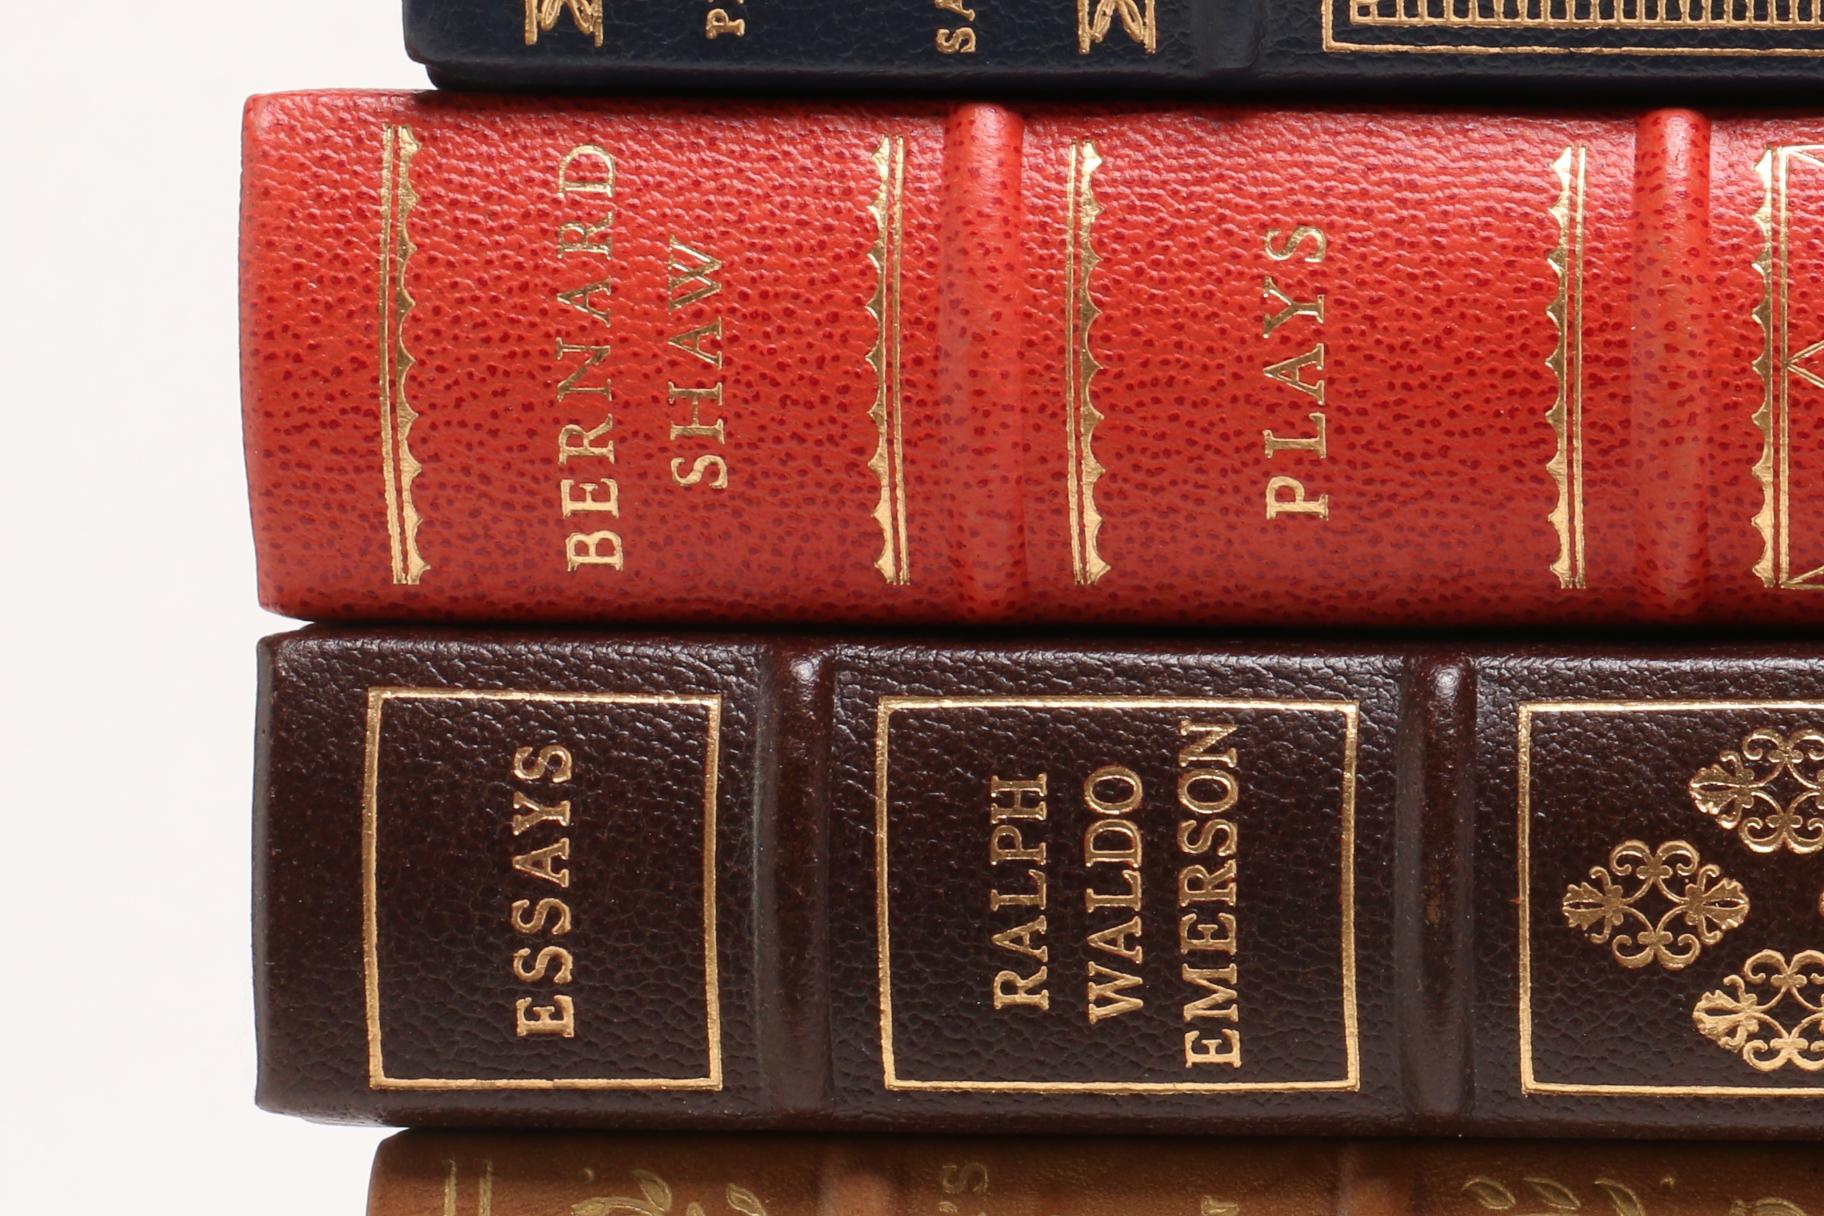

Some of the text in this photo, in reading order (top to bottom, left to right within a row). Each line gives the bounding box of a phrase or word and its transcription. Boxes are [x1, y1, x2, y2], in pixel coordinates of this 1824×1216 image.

[706, 0, 745, 39] P
[557, 143, 624, 571] BERNARD
[668, 238, 728, 490] SHAW
[1263, 225, 1330, 521] PLAYS
[511, 744, 575, 1039] ESSAYS
[991, 775, 1049, 1012] RALPH
[1083, 765, 1144, 1025] WALDO
[1174, 718, 1243, 1070] EMERSON
